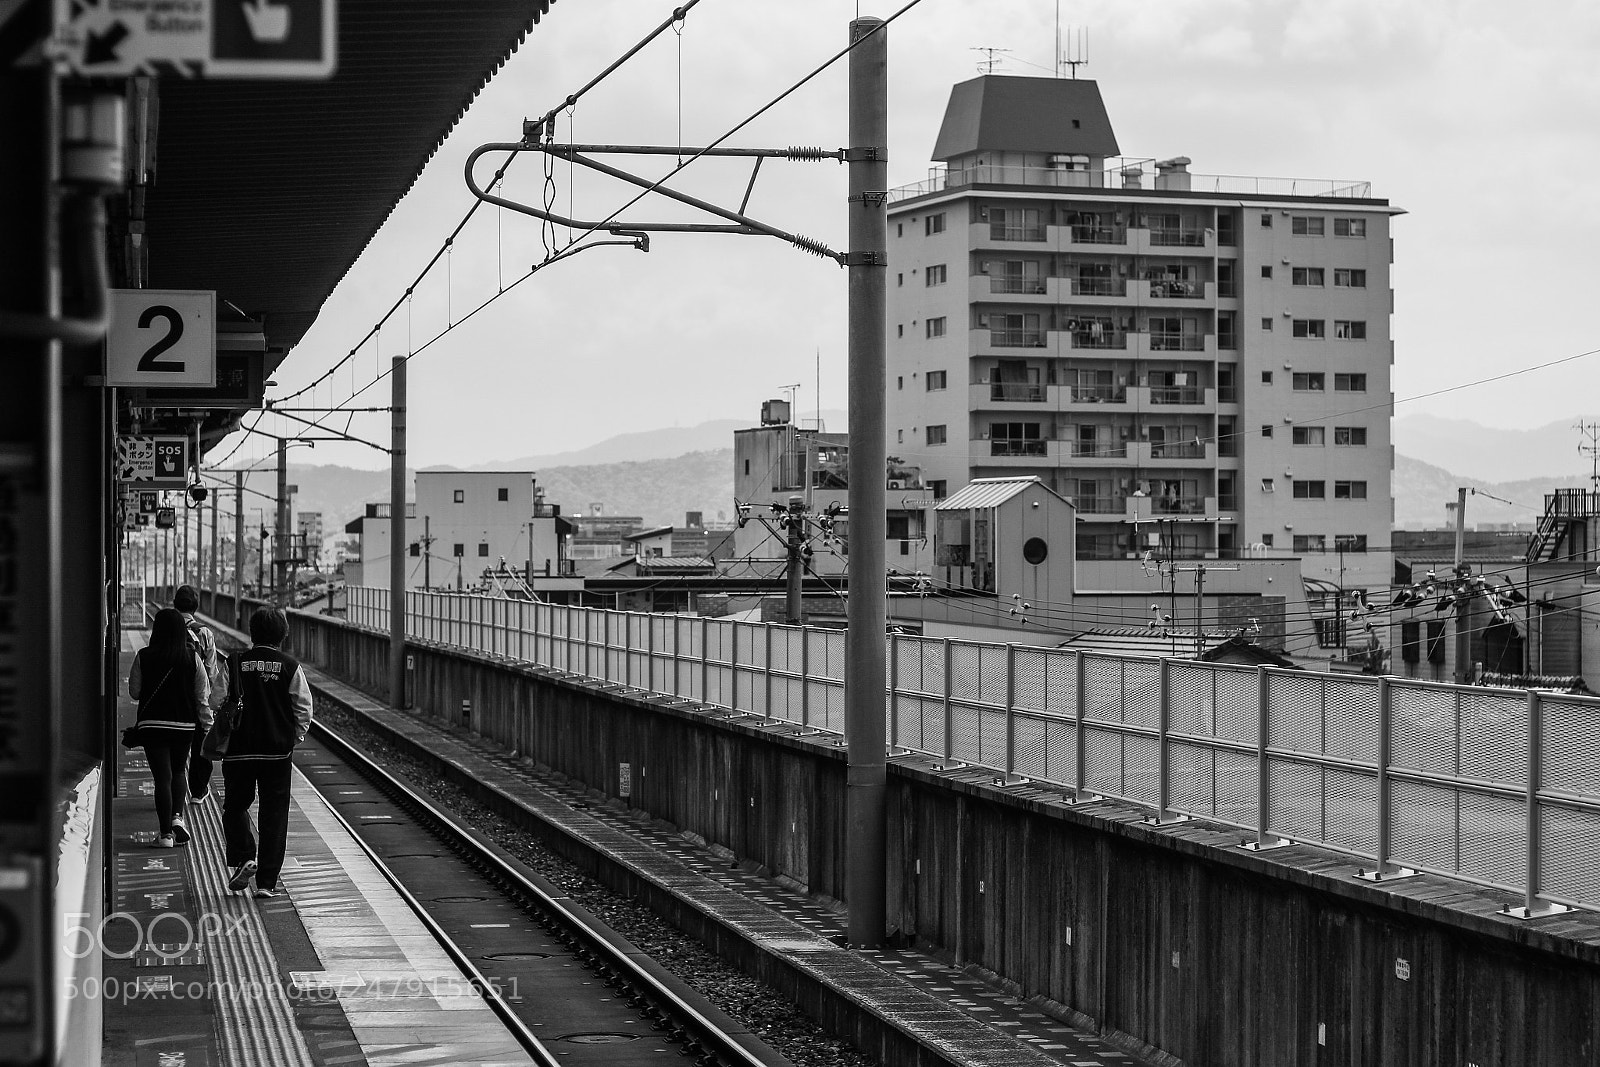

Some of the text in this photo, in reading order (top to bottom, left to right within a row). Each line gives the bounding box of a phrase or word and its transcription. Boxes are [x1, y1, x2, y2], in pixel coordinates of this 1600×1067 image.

[136, 305, 185, 373] 2
[129, 451, 153, 459] ボタン
[158, 446, 182, 455] SOS
